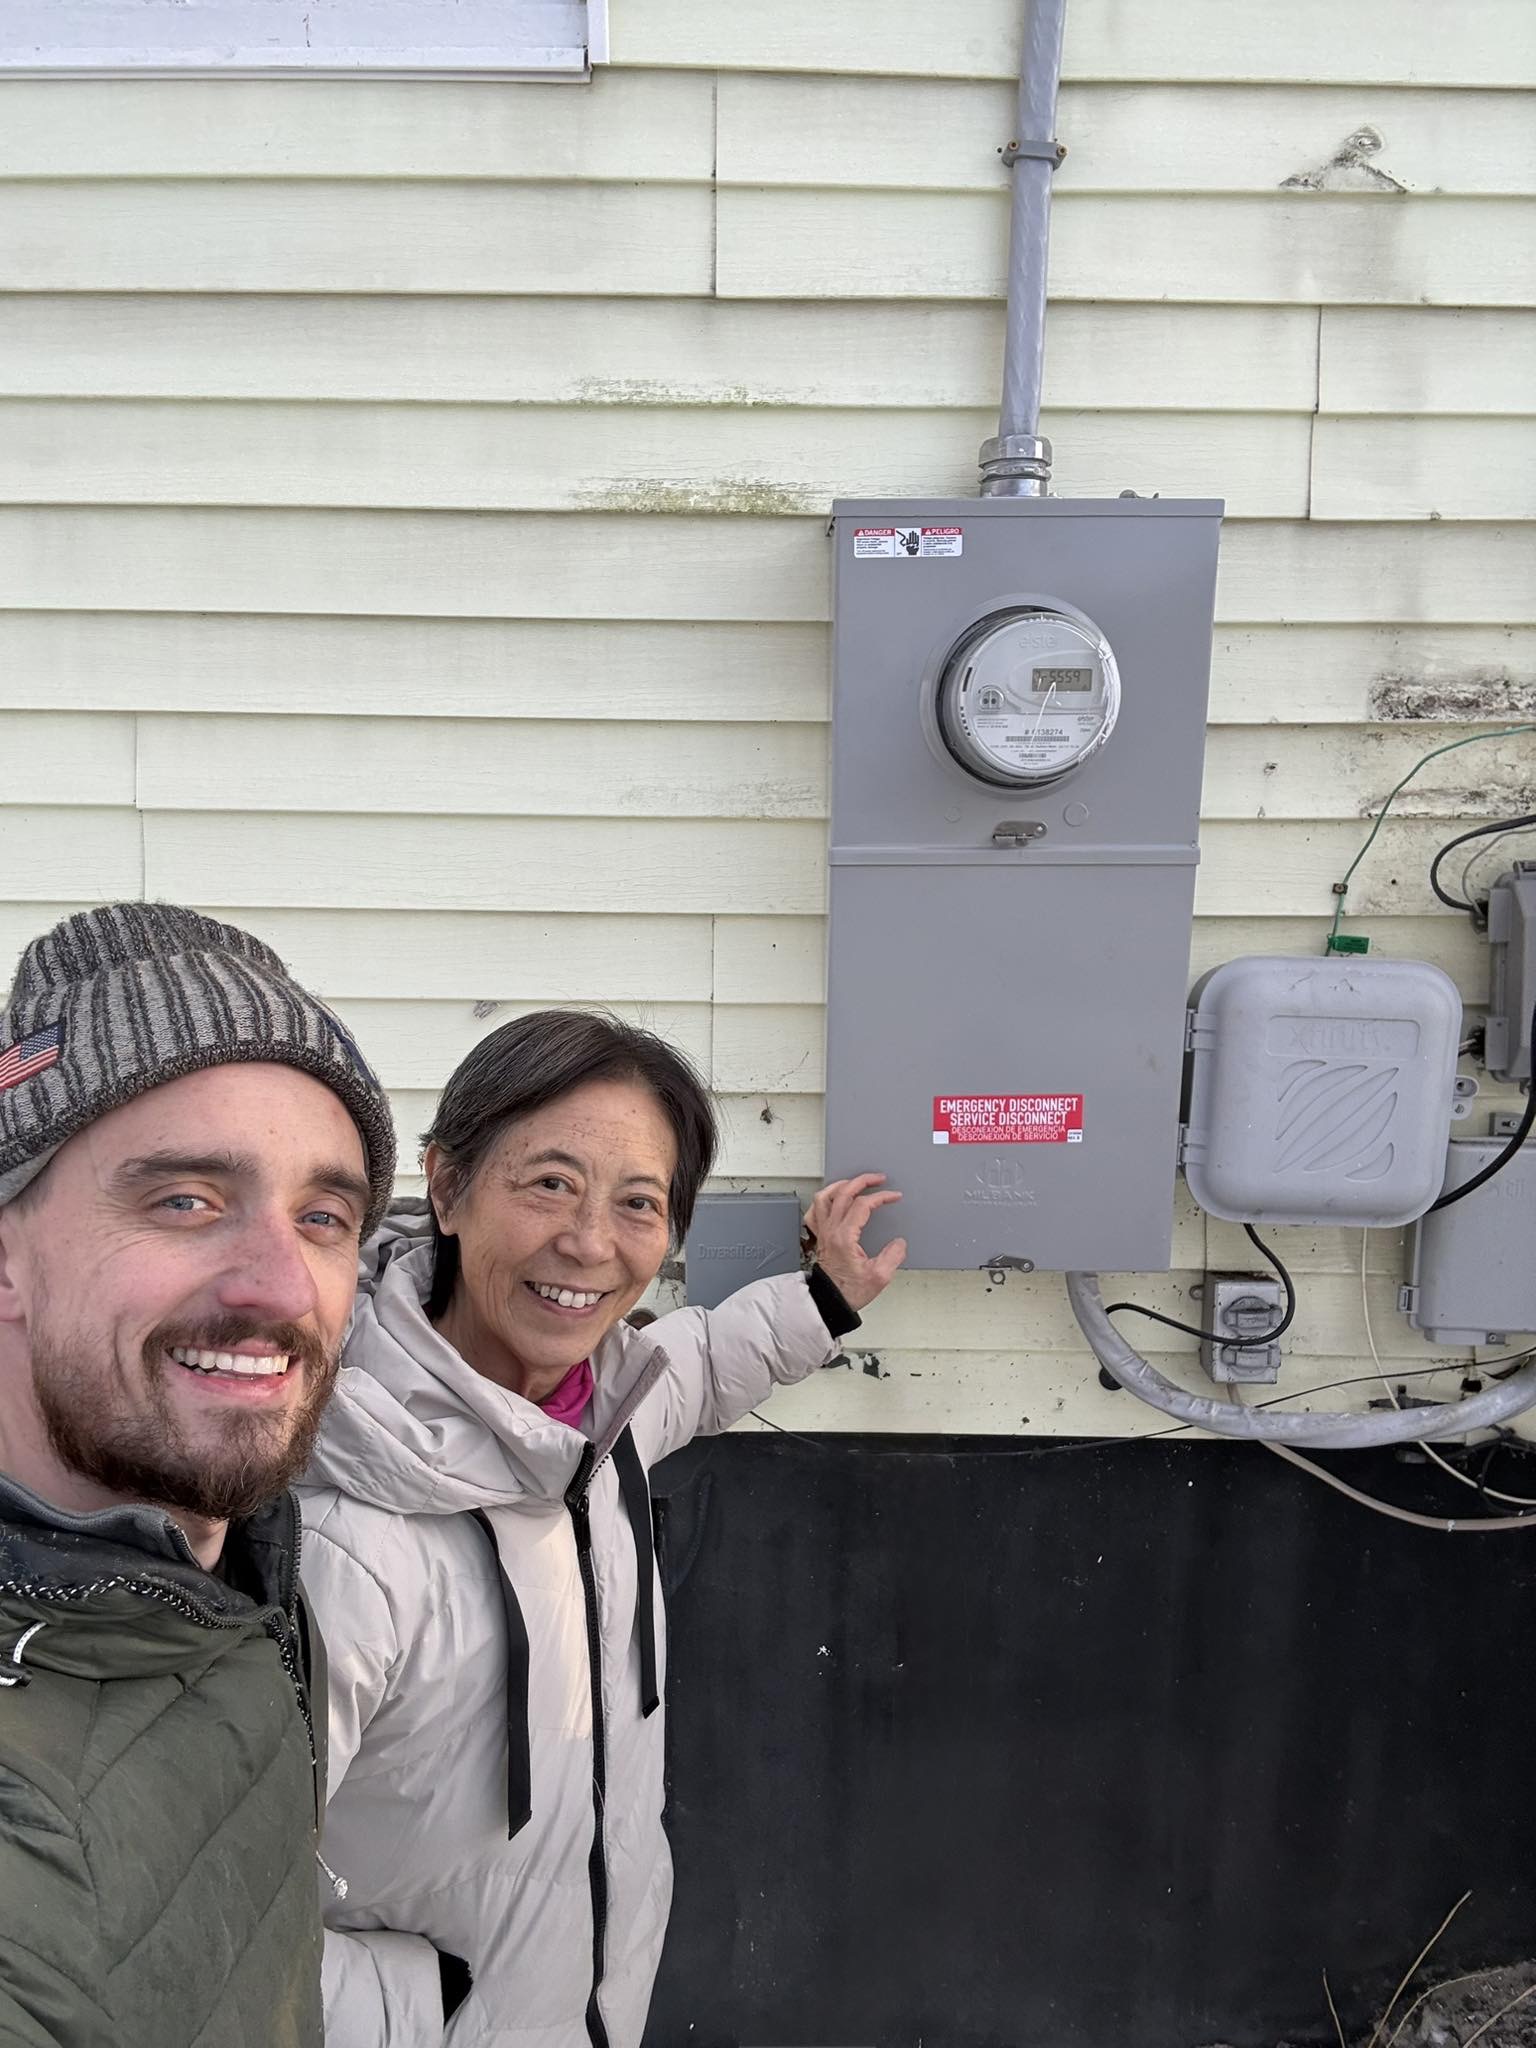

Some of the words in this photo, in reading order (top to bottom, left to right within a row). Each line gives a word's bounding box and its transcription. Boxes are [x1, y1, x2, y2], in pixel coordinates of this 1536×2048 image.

[940, 1098, 1006, 1114] EMERGENCY
[1009, 1097, 1078, 1112] DISCONNECT
[950, 1112, 996, 1126] SERVICE
[999, 1111, 1068, 1125] DISCONNECT
[1005, 1125, 1016, 1133] DE
[1017, 1124, 1066, 1133] EMERGENCIA
[1012, 1133, 1022, 1141] DE
[1024, 1132, 1058, 1141] SERVICIO
